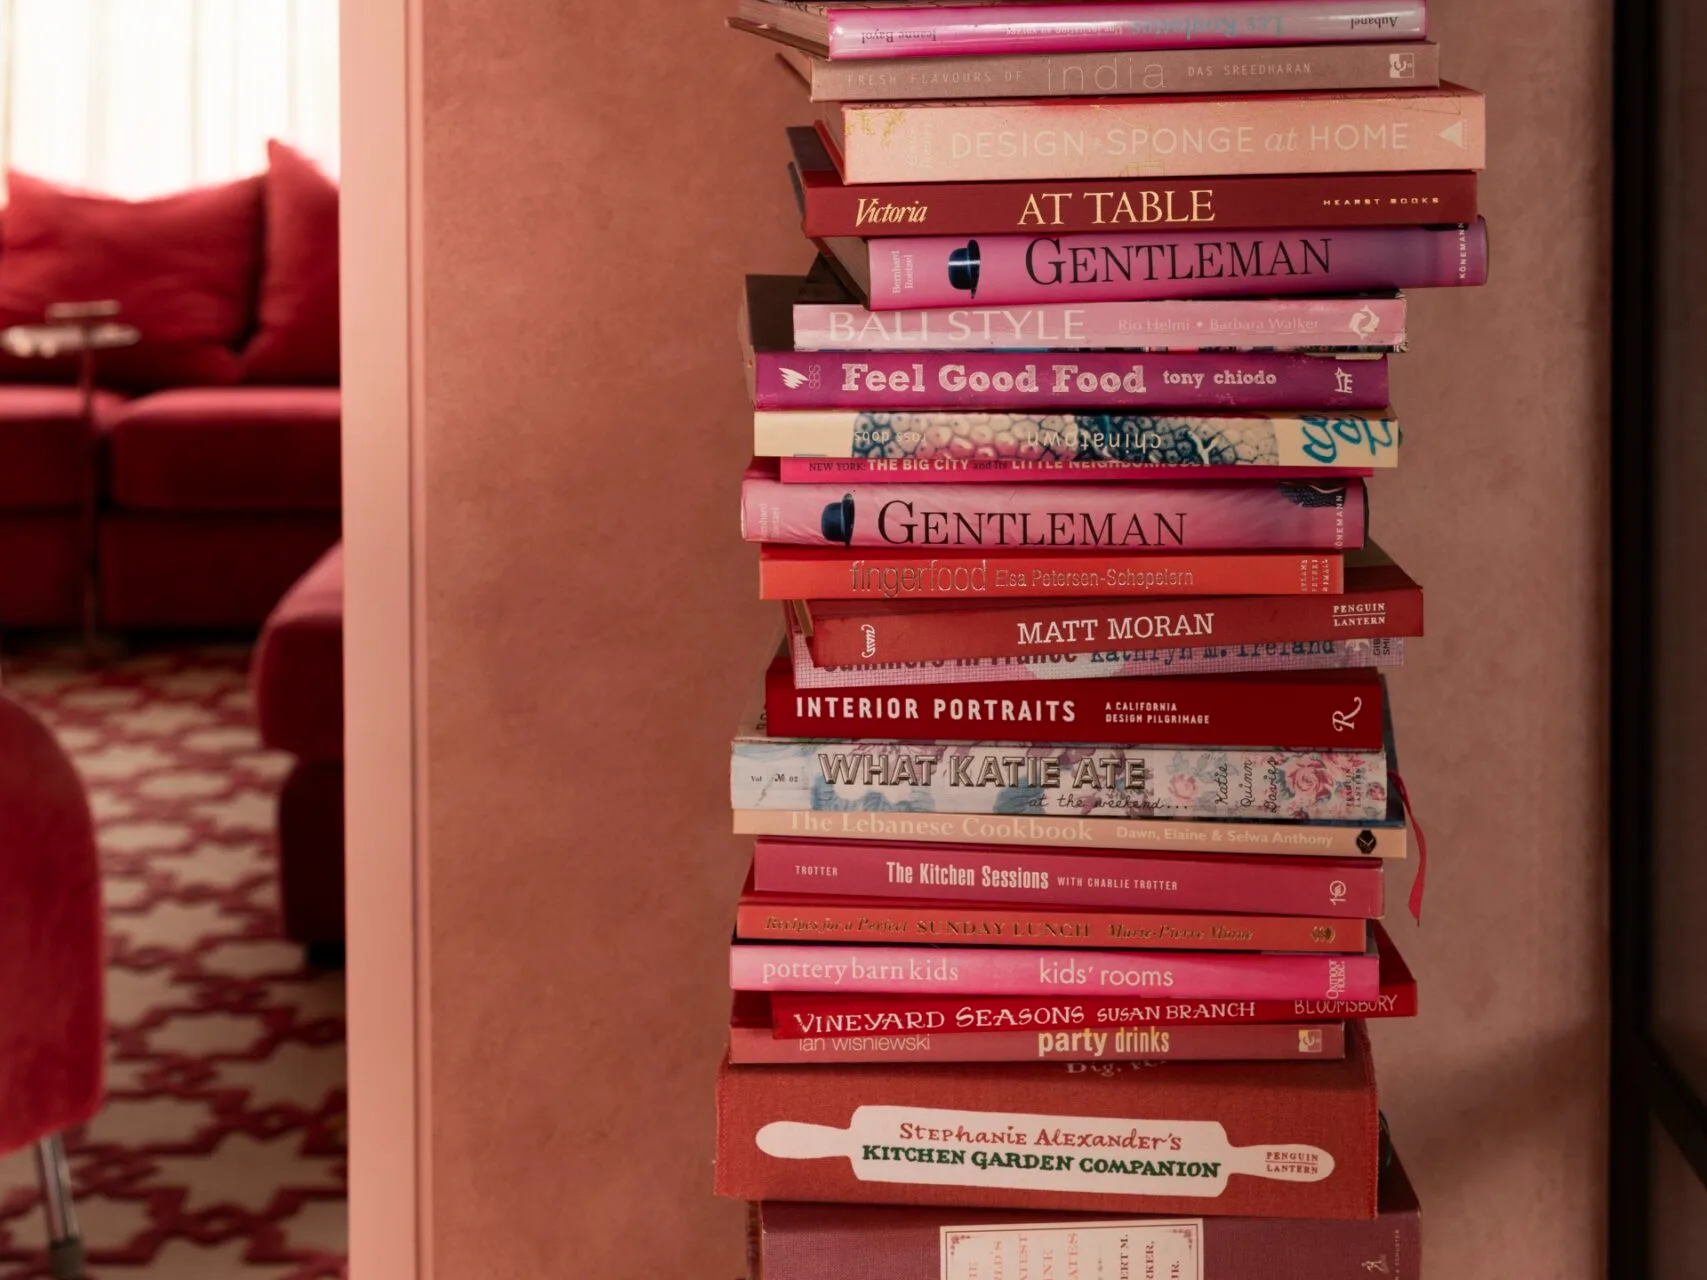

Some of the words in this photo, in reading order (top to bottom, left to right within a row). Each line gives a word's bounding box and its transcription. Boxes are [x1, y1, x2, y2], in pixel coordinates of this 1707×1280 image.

[1350, 16, 1399, 30] Aubanel
[861, 29, 894, 44] Bayol
[898, 29, 937, 42] Jeanne
[848, 73, 898, 86] FRESH
[911, 71, 993, 85] FLAVOURS
[1187, 65, 1213, 77] DAS
[1223, 63, 1312, 76] SREEDHARAN
[951, 131, 1085, 159] DESIGN
[1107, 127, 1254, 155] SPONGE
[1265, 129, 1298, 152] at
[1311, 123, 1409, 151] HOME
[855, 198, 928, 227] Victoria
[1016, 192, 1073, 225] AT
[1083, 189, 1216, 224] TABLE
[1024, 236, 1332, 285] GENTLEMAN
[828, 310, 928, 341] BALI
[947, 309, 1086, 341] STYLE
[842, 363, 926, 393] Feel
[938, 363, 1039, 393] Good
[1052, 364, 1147, 394] Food
[1162, 370, 1205, 389] tony
[1213, 369, 1277, 386] chiodo
[867, 458, 897, 471] THE
[902, 458, 931, 471] BIG
[934, 458, 969, 471] CITY
[877, 499, 1188, 548] GENTLEMAN
[1333, 602, 1386, 614] PENGUIN
[1017, 618, 1098, 645] MATT
[1107, 612, 1215, 640] MORAN
[1333, 616, 1386, 627] LANTERN
[796, 696, 919, 719] INTERIOR
[933, 698, 1077, 722] PORTRAITS
[1116, 702, 1178, 711] CALIFORNIA
[1105, 714, 1143, 723] DESIGN
[1147, 714, 1210, 724] PILGRIMAGE
[818, 752, 938, 787] WHAT
[949, 754, 1061, 789] KATIE
[1071, 756, 1146, 791] ATE
[1213, 762, 1229, 806] Katie
[1239, 759, 1253, 809] Quinn
[788, 811, 832, 832] The
[842, 811, 955, 837] Lebanese
[962, 816, 1093, 842] Cookbook
[1164, 827, 1207, 842] Elaine
[1271, 831, 1334, 848] Anthony
[795, 865, 838, 876] TROTTER
[886, 861, 913, 883] The
[919, 862, 975, 887] Kitchen
[981, 865, 1049, 889] Sessions
[1057, 876, 1083, 887] WITH
[1087, 877, 1130, 889] CHARLIE
[1134, 879, 1177, 891] TROTTER
[916, 919, 1005, 937] SUNDAY
[1012, 921, 1091, 938] LUNCH
[762, 959, 846, 985] pottery
[851, 956, 905, 980] barn
[908, 957, 959, 981] kids
[1039, 957, 1095, 985] kids'
[1100, 968, 1174, 987] rooms
[793, 1009, 945, 1033] VINEYARD
[955, 1005, 1085, 1028] SEASONS
[1096, 1003, 1161, 1022] SUSAN
[1165, 1001, 1256, 1019] BRANCH
[832, 1033, 931, 1051] wisniewski
[1038, 1027, 1107, 1057] party
[1115, 1026, 1170, 1054] drinks
[862, 1144, 966, 1166] KITCHEN
[971, 1150, 1074, 1171] GARDEN
[1079, 1156, 1221, 1179] COMPANION
[1266, 1151, 1319, 1162] PENGUIN
[1266, 1163, 1319, 1175] LANTERN
